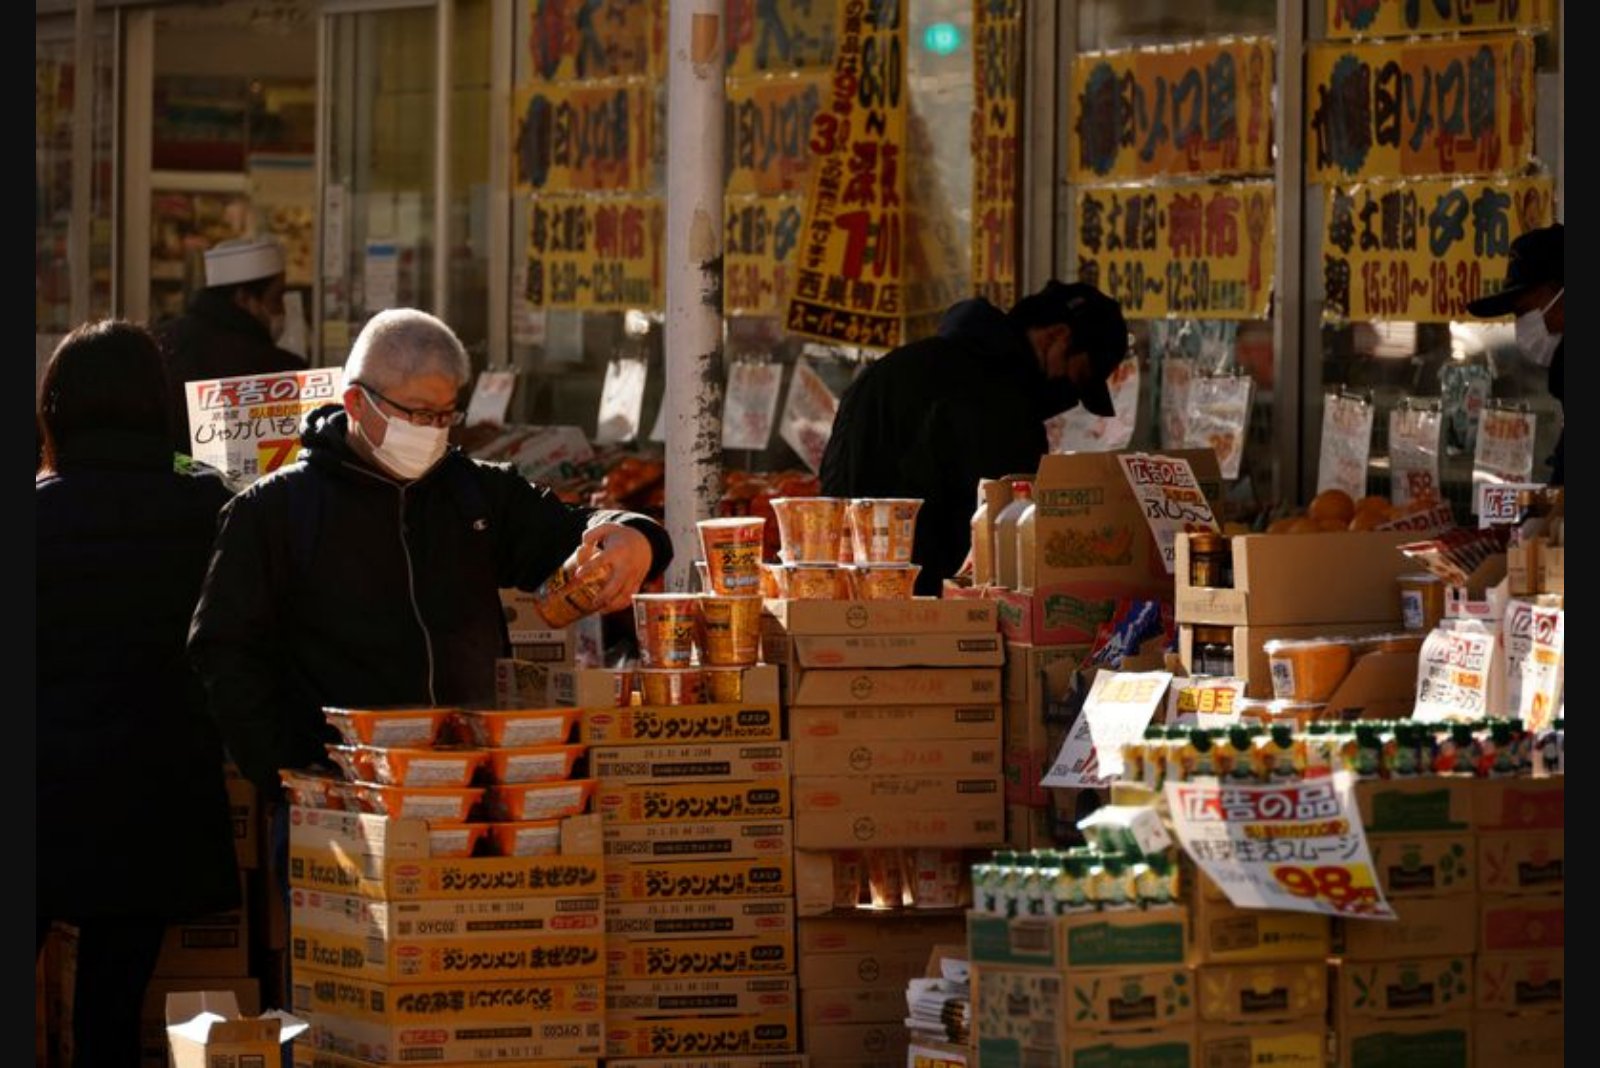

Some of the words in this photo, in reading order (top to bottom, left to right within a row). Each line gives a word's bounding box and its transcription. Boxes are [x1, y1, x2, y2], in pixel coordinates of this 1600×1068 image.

[197, 373, 334, 410] 広告の品
[195, 417, 298, 444] じゃがいも
[1126, 458, 1197, 489] 広告の品
[1179, 782, 1339, 822] 広告の品
[1273, 864, 1353, 900] 98
